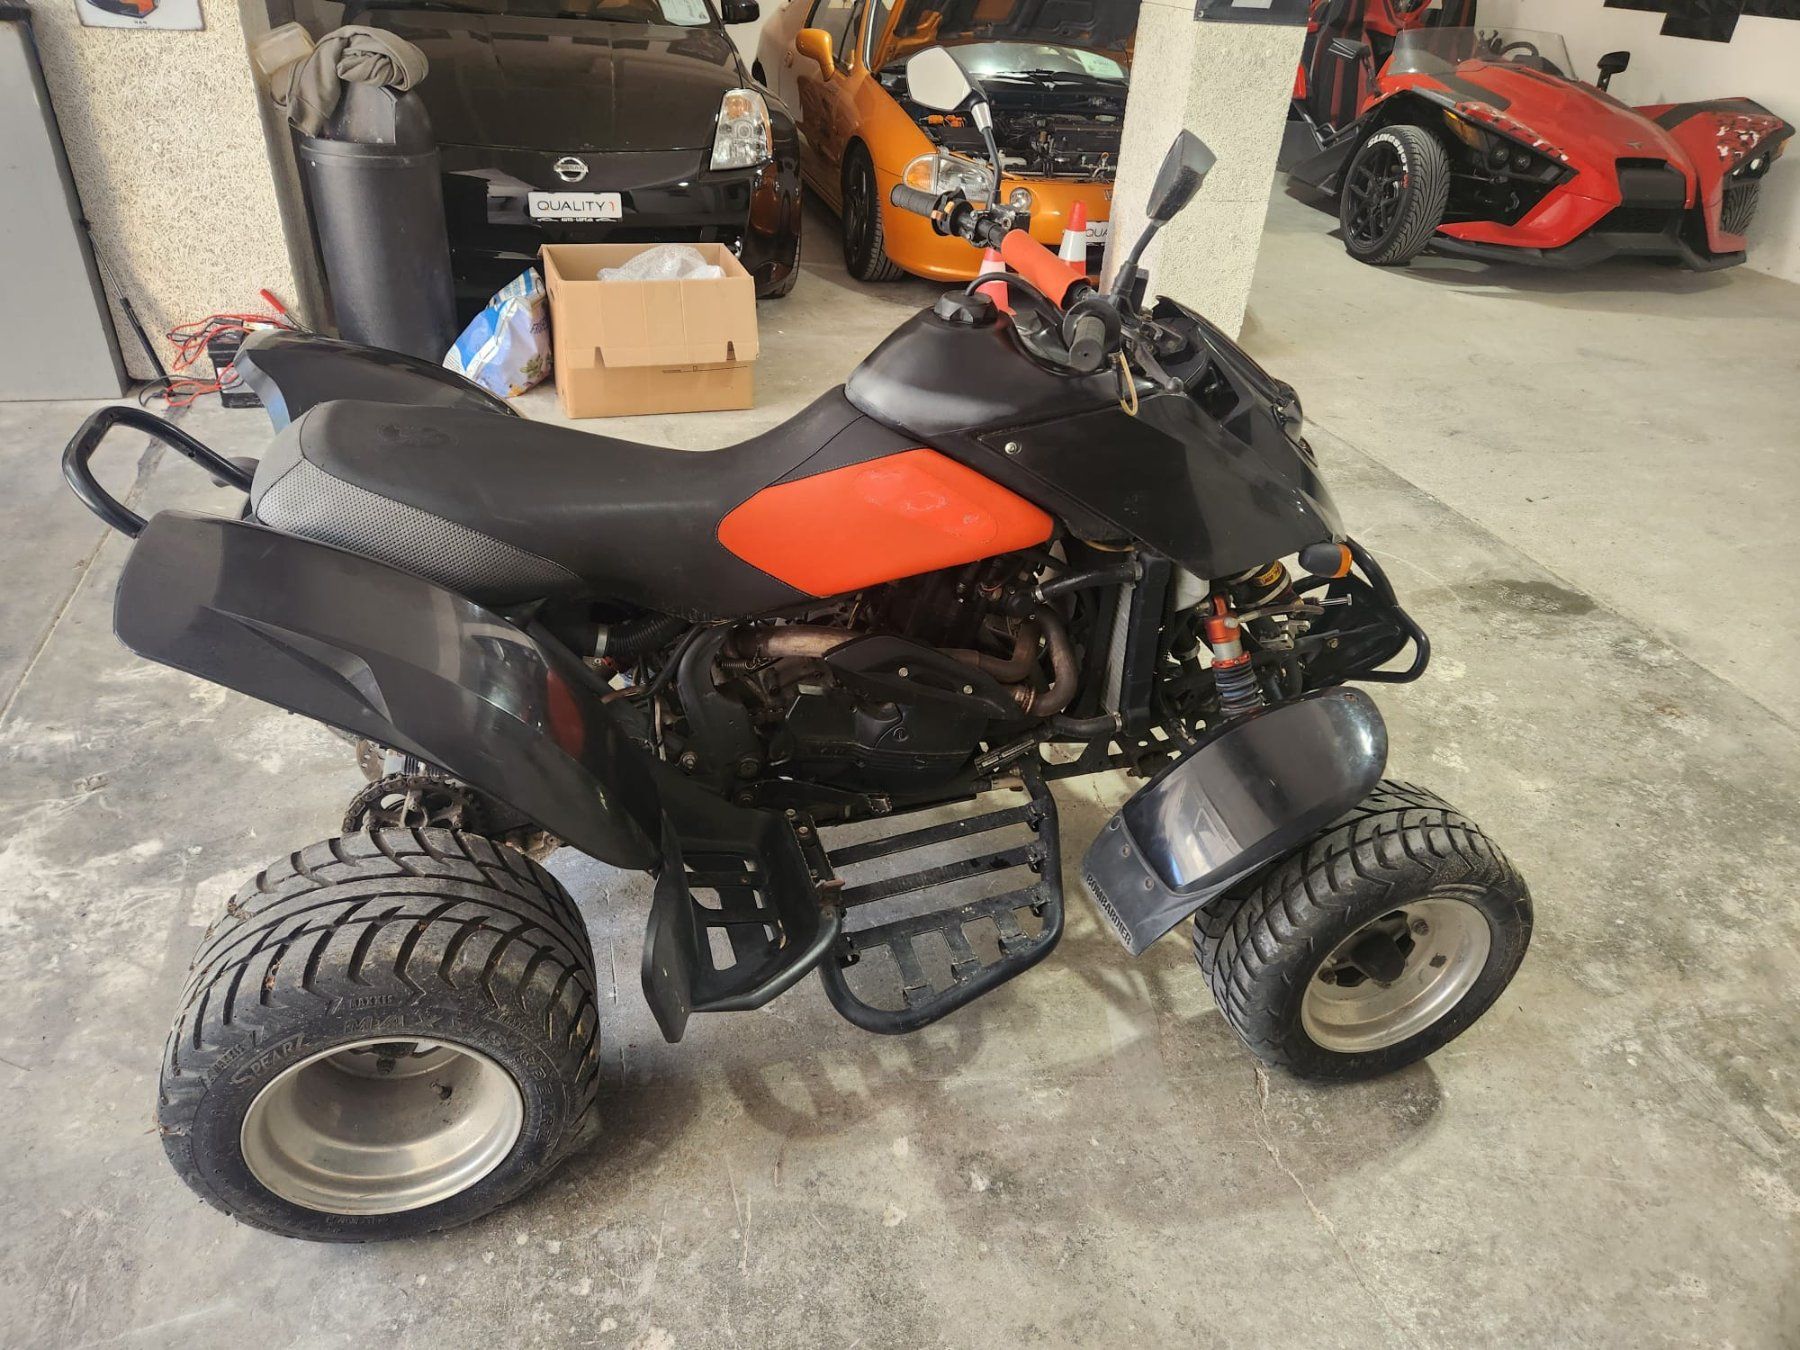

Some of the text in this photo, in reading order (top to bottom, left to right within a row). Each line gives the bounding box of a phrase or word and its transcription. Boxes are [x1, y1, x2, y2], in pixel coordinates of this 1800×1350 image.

[1367, 133, 1409, 173] SLINGSHOT
[537, 200, 606, 212] QUALITY
[1086, 873, 1132, 946] BOMBARDIER
